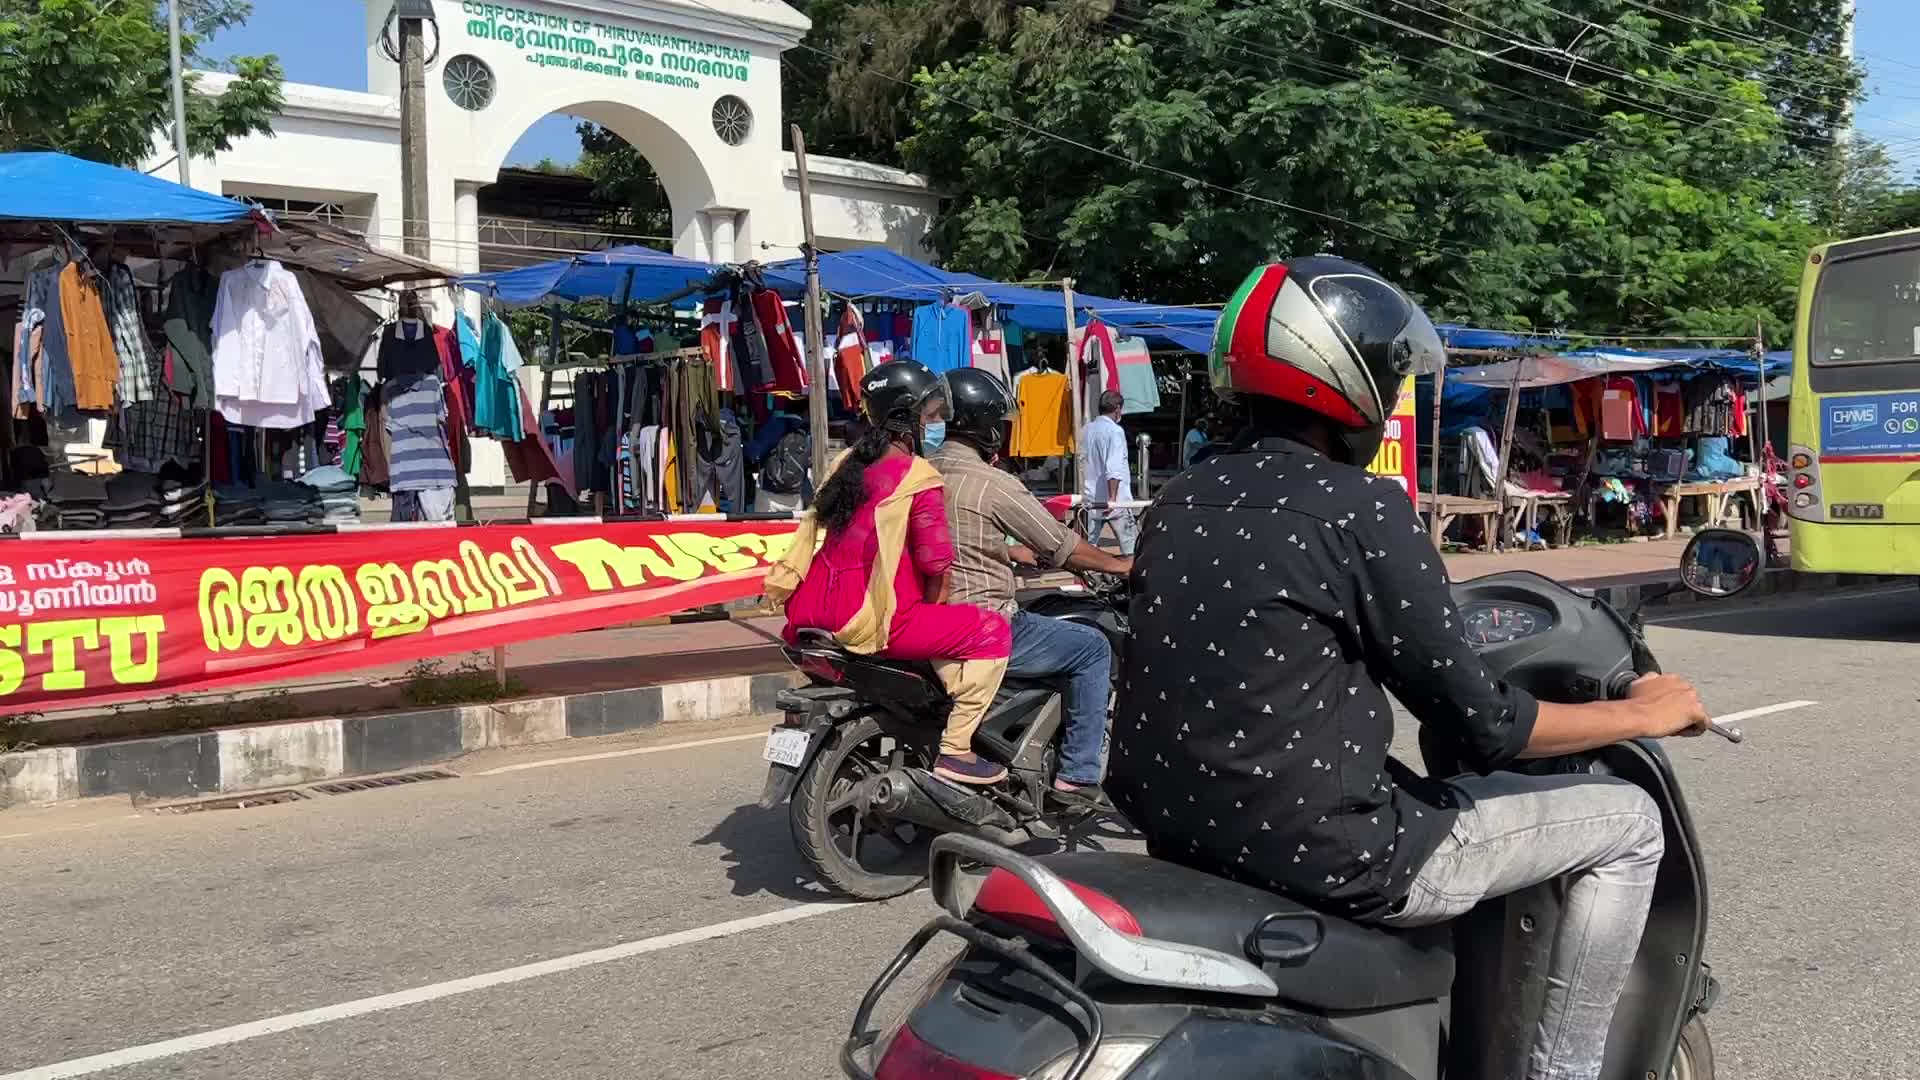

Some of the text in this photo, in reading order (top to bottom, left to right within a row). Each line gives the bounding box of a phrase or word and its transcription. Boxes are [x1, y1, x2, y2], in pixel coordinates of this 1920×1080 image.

[462, 1, 750, 64] CORPORATION OF THIRUVANANTHAPURAM
[467, 17, 748, 82] തിരുവനന്തപുരം നഗരസഭ
[1891, 401, 1918, 413] FOR
[1832, 505, 1881, 517] TATA
